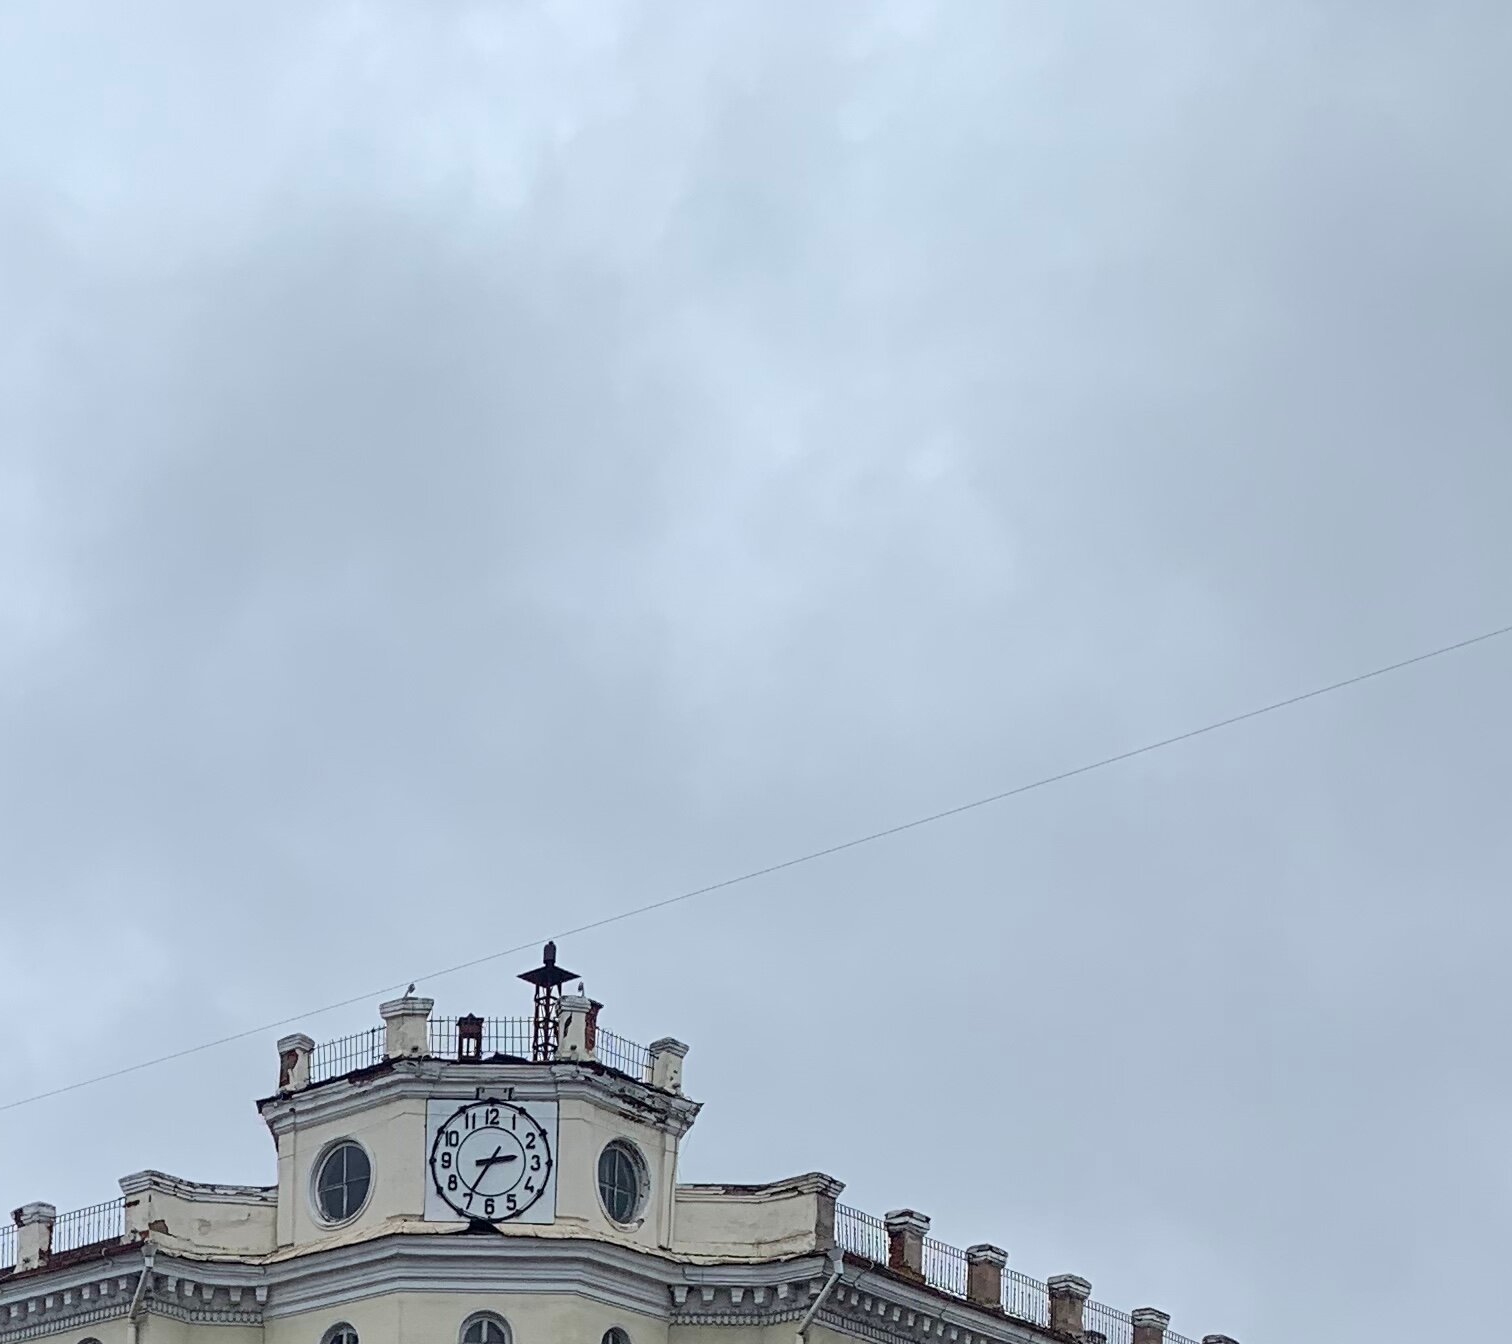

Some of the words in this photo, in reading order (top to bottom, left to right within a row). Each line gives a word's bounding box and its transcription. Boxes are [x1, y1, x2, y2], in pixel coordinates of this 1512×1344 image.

[465, 1112, 476, 1129] 11
[485, 1108, 500, 1125] 12
[445, 1130, 459, 1147] 10
[525, 1132, 536, 1149] 2
[441, 1152, 452, 1169] 9
[530, 1154, 541, 1171] 3
[447, 1174, 458, 1191] 8
[524, 1176, 534, 1193] 4
[463, 1192, 473, 1210] 7
[484, 1198, 495, 1215] 6
[506, 1193, 516, 1211] 5
